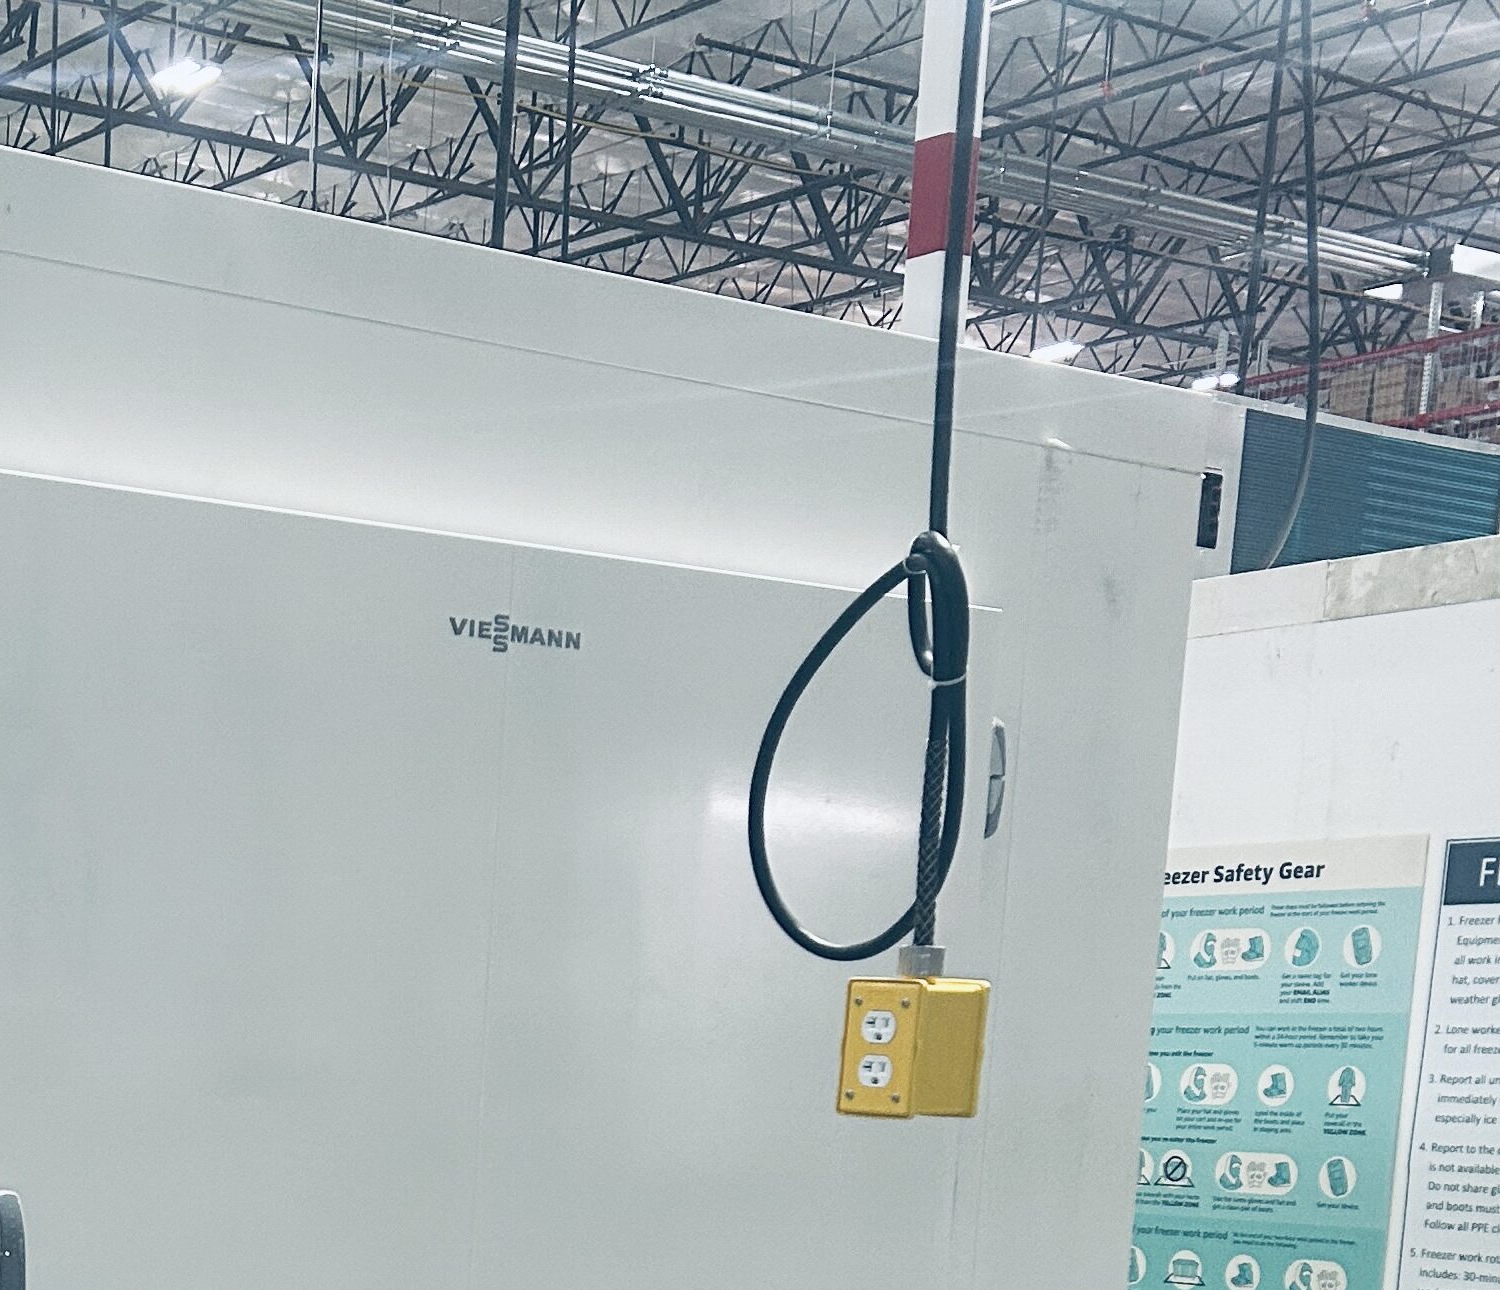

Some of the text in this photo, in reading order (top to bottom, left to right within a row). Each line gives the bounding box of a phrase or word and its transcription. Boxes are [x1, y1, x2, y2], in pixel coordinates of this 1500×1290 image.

[449, 613, 581, 653] VIESSMANN
[1213, 863, 1274, 885] Safety
[1279, 861, 1326, 879] Gear
[1480, 857, 1500, 887] F
[1161, 908, 1169, 918] of
[1171, 909, 1188, 920] your
[1189, 907, 1217, 917] freezer
[1218, 907, 1238, 916] work
[1239, 905, 1265, 917] period
[1459, 915, 1495, 926] Freezer
[1454, 955, 1466, 965] all
[1468, 955, 1492, 965] work
[1452, 974, 1500, 986] hat, cover
[1450, 994, 1490, 1005] weather
[1446, 1024, 1469, 1034] Lone
[1444, 1043, 1457, 1054] for
[1460, 1044, 1471, 1054] all
[1439, 1074, 1472, 1085] Report
[1475, 1074, 1486, 1084] all
[1437, 1093, 1497, 1106] immediately
[1435, 1114, 1497, 1126] especially ice
[1431, 1142, 1464, 1154] Report
[1466, 1145, 1476, 1154] to
[1479, 1144, 1495, 1155] the
[1429, 1162, 1500, 1175] is not available
[1428, 1181, 1441, 1191] Do
[1443, 1183, 1460, 1192] not
[1462, 1183, 1489, 1193] share
[1426, 1201, 1444, 1210] and
[1446, 1202, 1473, 1212] boots
[1424, 1219, 1454, 1230] Follow
[1457, 1221, 1469, 1231] all
[1471, 1222, 1490, 1233] PPE
[1420, 1248, 1456, 1260] Freezer
[1459, 1252, 1483, 1262] work
